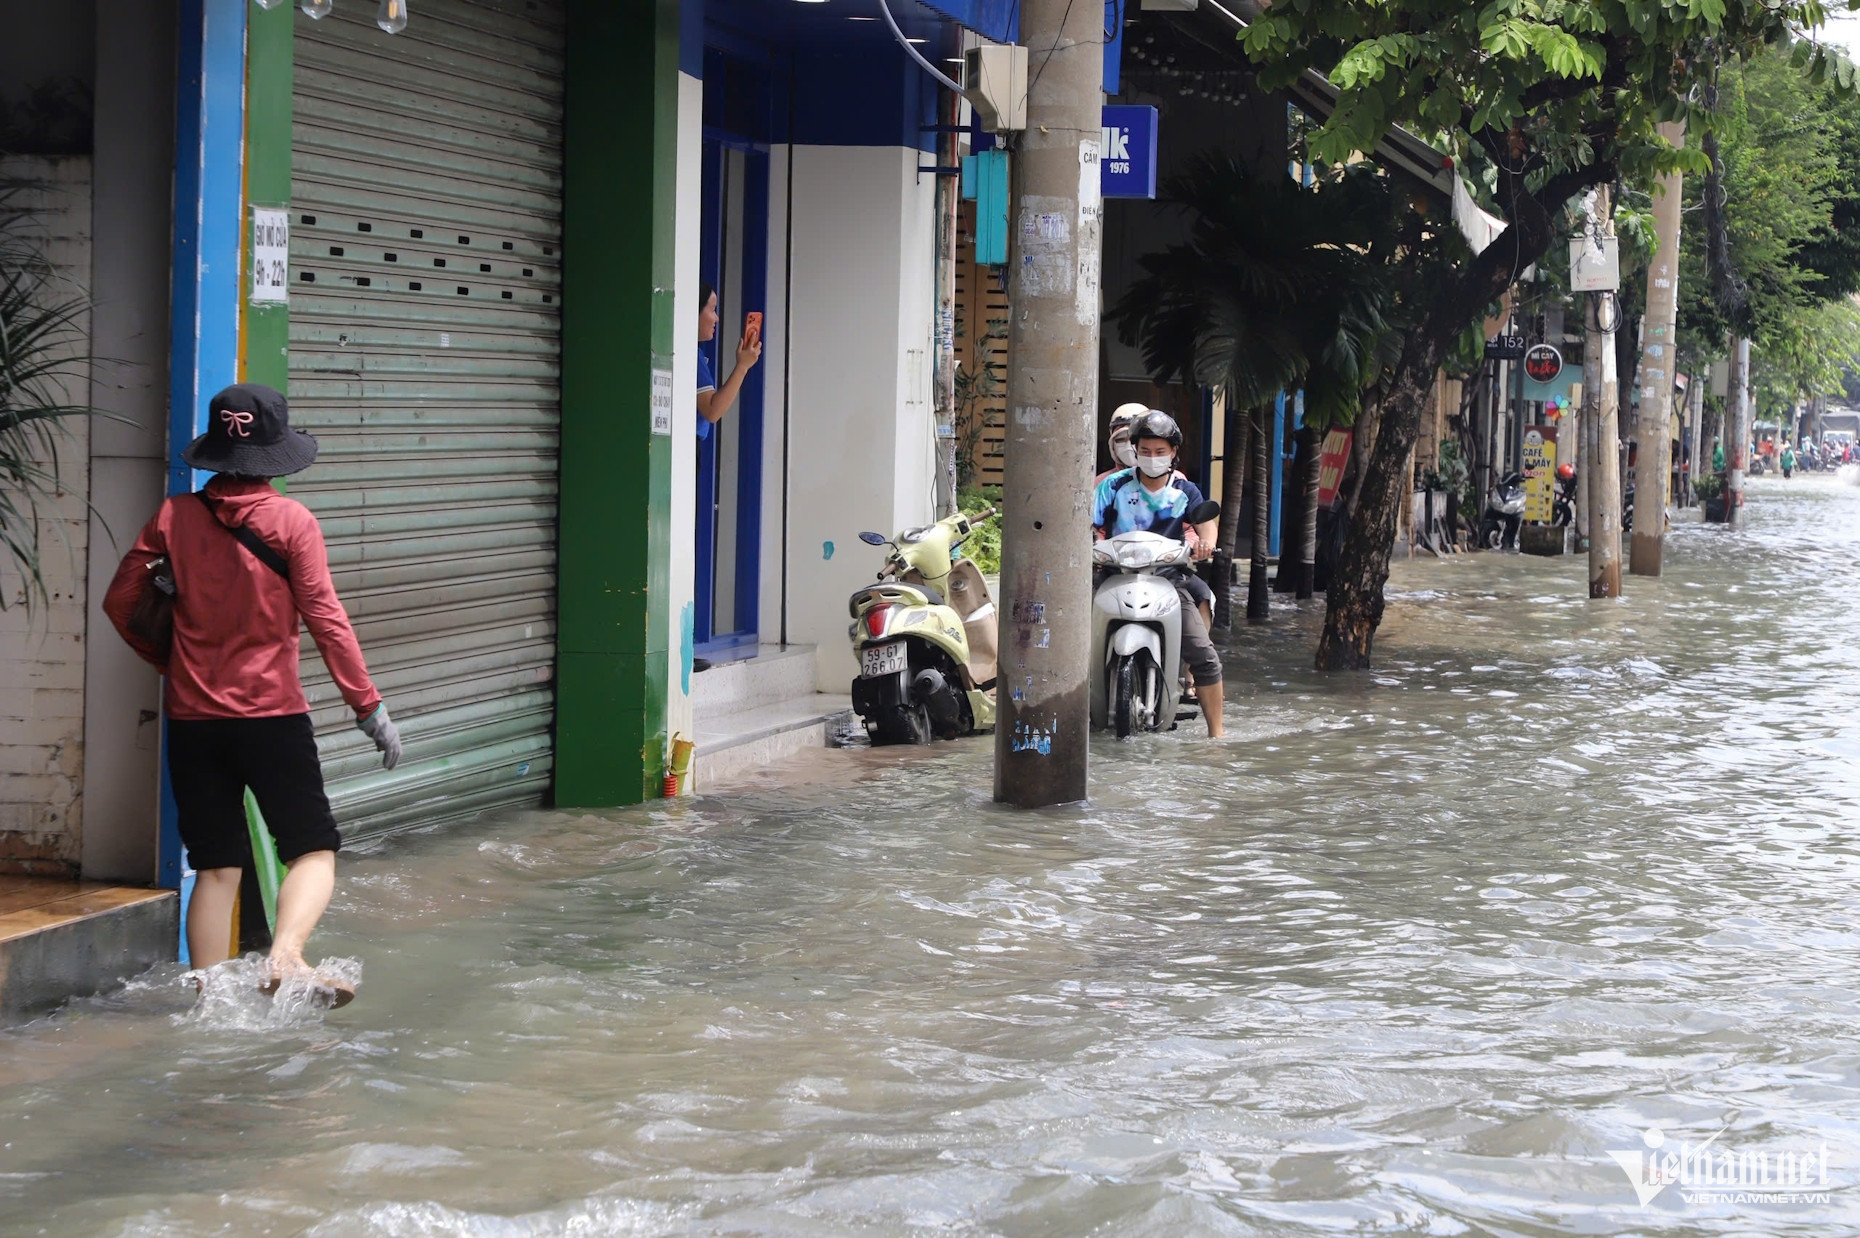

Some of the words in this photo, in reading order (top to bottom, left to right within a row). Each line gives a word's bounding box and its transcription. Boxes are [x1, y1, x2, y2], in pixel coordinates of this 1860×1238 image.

[1101, 127, 1130, 159] lk
[1109, 162, 1130, 174] 1976
[256, 258, 264, 286] 9h
[271, 259, 285, 286] 22h
[1503, 336, 1524, 349] 152
[1541, 352, 1554, 360] CAY
[867, 644, 898, 662] 59-G1
